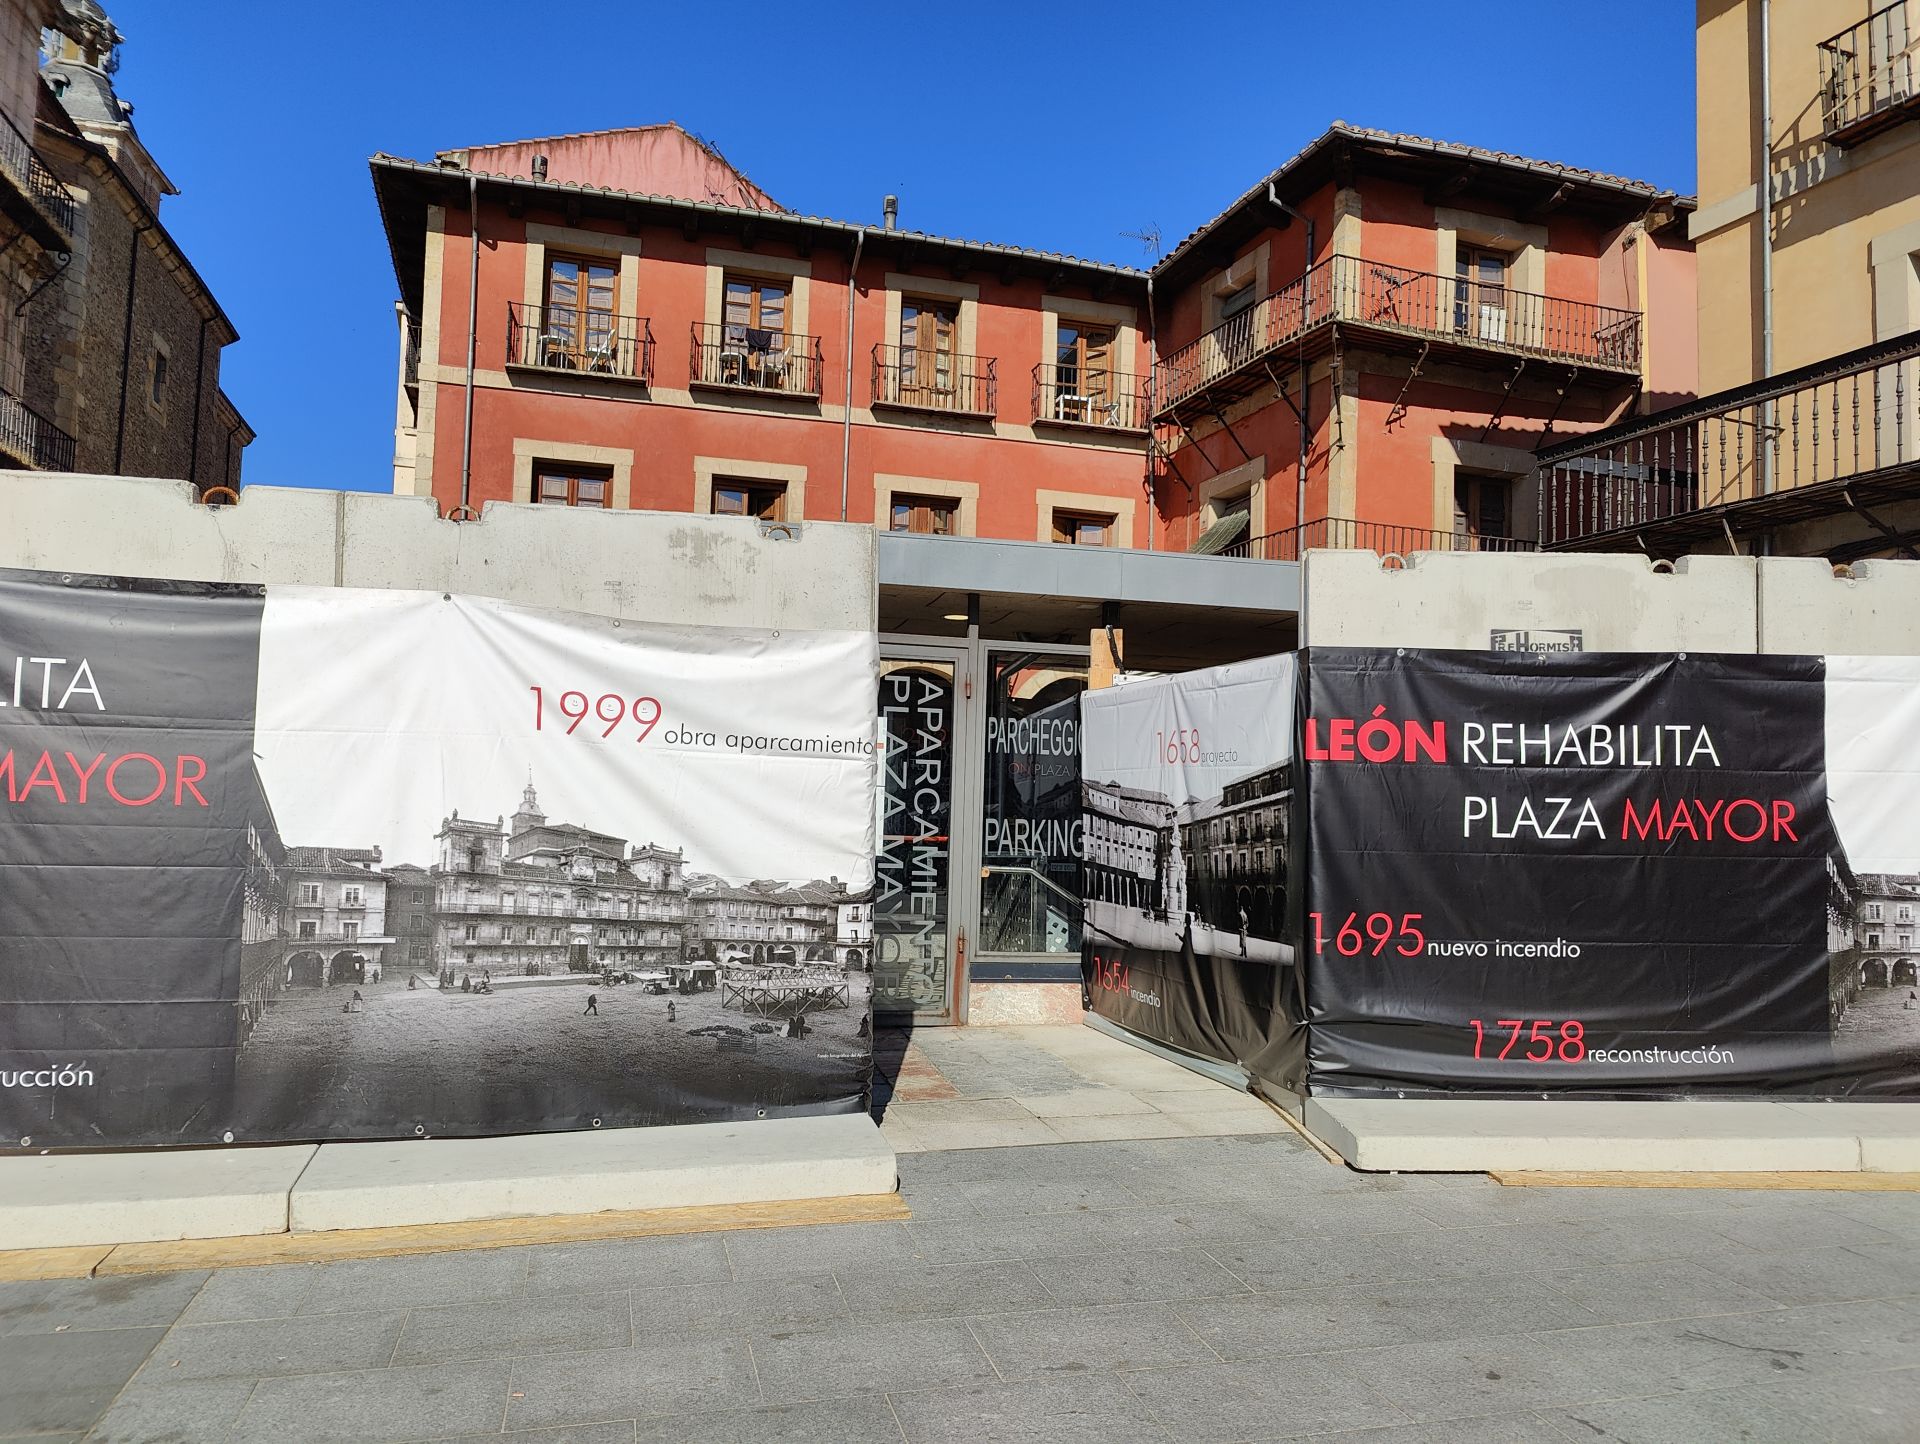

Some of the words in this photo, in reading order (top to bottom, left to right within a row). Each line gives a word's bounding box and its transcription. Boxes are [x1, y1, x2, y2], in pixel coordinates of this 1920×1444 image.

[0, 657, 106, 711] ITA
[530, 686, 662, 743] 1999
[664, 723, 716, 746] obra
[725, 734, 873, 755] aparcamiento
[1157, 728, 1200, 764] 1658
[1201, 747, 1238, 765] proyecto
[1305, 704, 1446, 763] LEÓN
[1463, 722, 1720, 767] REHABILITA
[883, 675, 911, 820] PLAZA
[909, 677, 944, 1004] APARCAMIENTO
[985, 818, 1082, 858] PARKING
[1464, 796, 1606, 840] PLAZA
[1622, 798, 1798, 842] MAYOR
[874, 834, 905, 1000] MAYOR
[1310, 912, 1424, 957] 1695
[1427, 941, 1488, 958] nuevo
[1495, 937, 1581, 959] incendio
[1094, 957, 1130, 996] 1654
[1130, 985, 1161, 1008] incendio
[1470, 1020, 1585, 1063] 1758
[1587, 1045, 1735, 1064] reconstrucción
